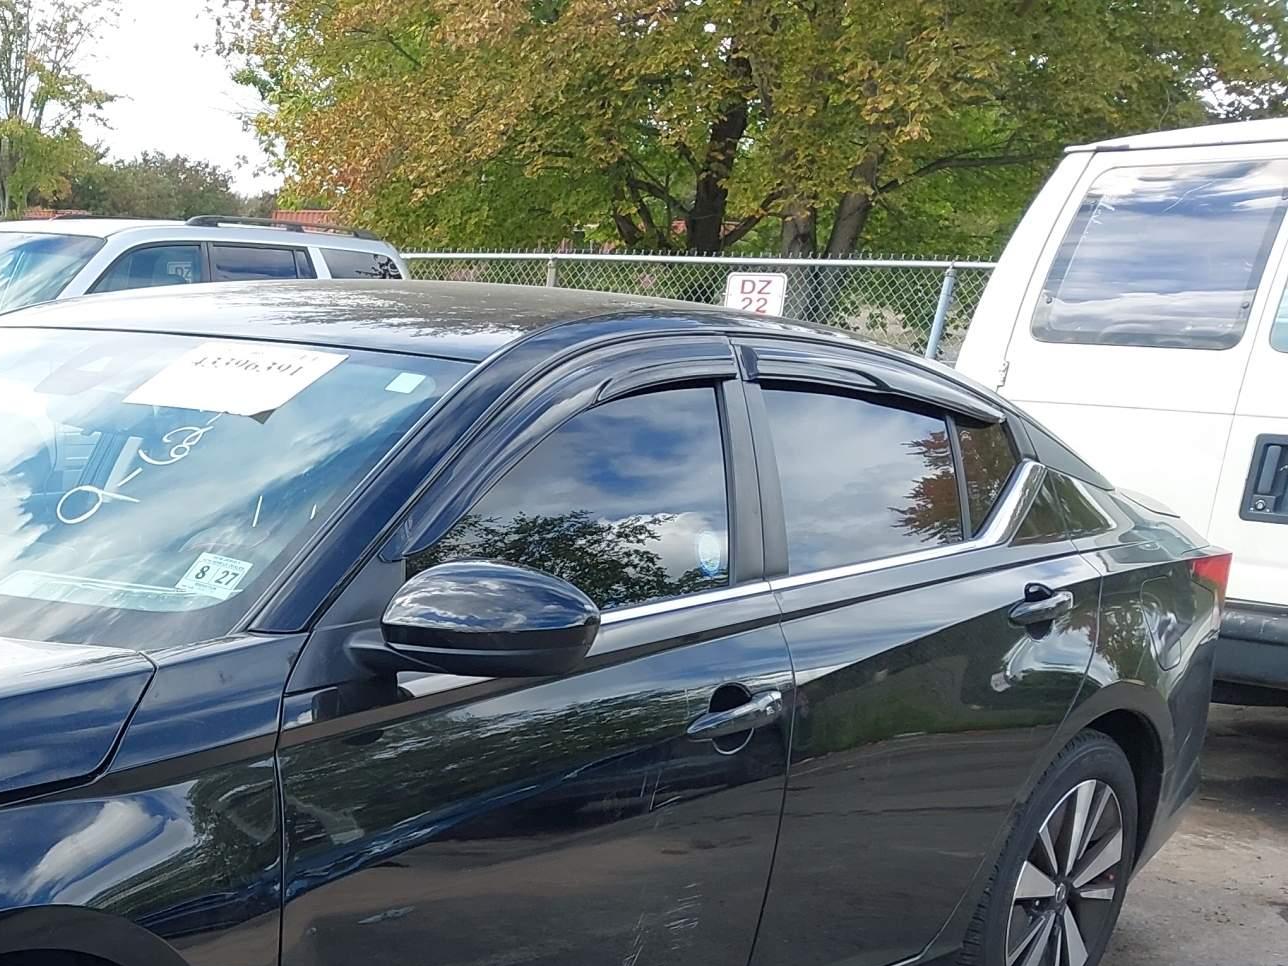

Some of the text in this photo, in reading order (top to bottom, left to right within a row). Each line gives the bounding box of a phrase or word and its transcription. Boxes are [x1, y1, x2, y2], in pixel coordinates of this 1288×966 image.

[740, 279, 773, 295] DZ
[741, 297, 768, 313] 22
[195, 565, 240, 586] 8 27
